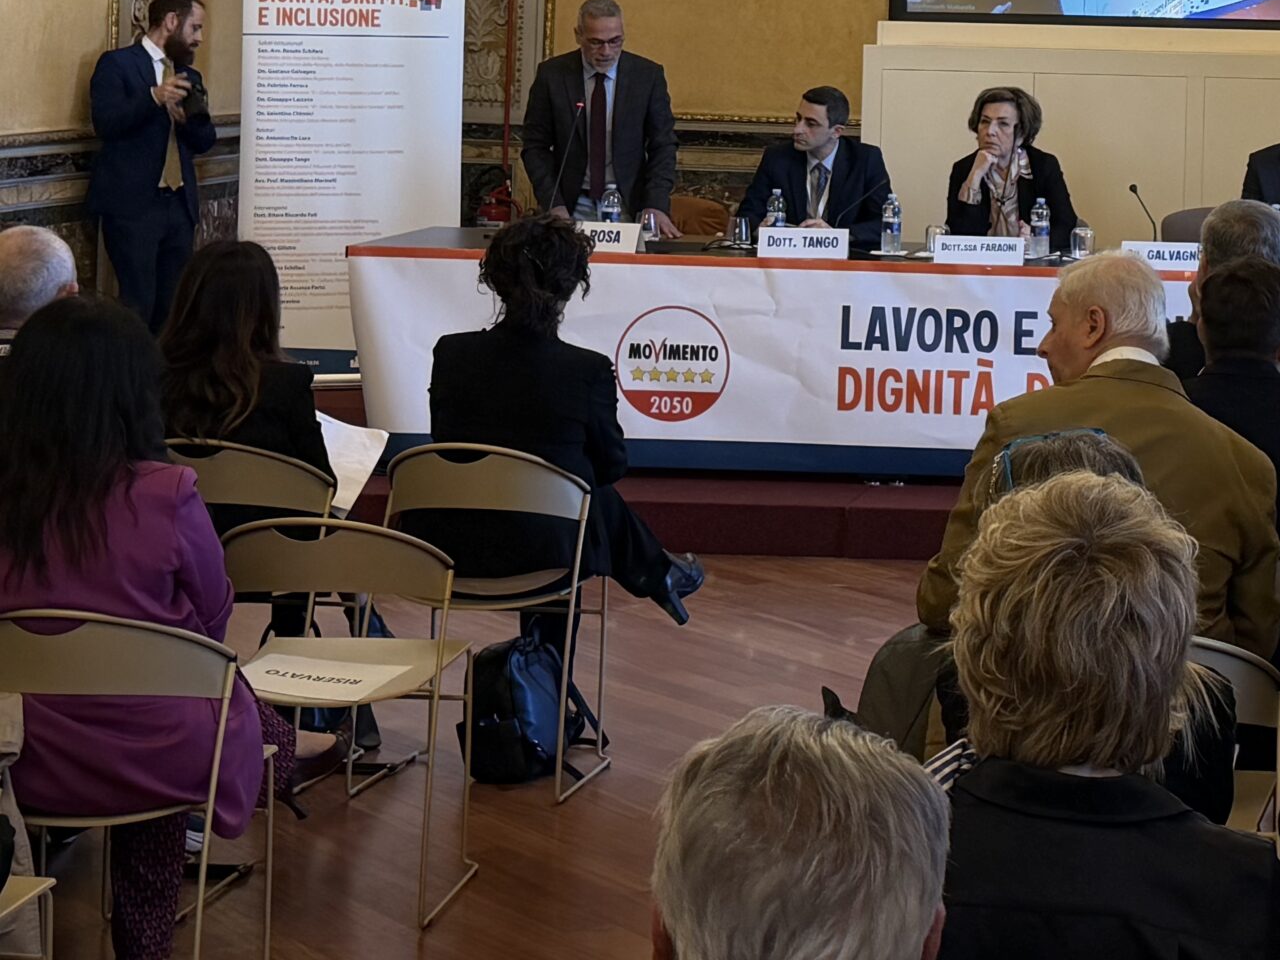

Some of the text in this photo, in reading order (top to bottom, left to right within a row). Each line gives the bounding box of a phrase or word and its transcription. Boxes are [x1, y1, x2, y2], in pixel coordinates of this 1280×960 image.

[258, 7, 381, 27] E INCLUSIONE
[590, 229, 621, 244] ROSA
[802, 236, 839, 249] TANGO
[980, 243, 1017, 252] FARAONI
[840, 305, 1038, 356] LAVORO E
[628, 338, 719, 363] MOVIMENTO
[649, 396, 693, 414] 2050
[264, 669, 363, 686] RISERVATO
